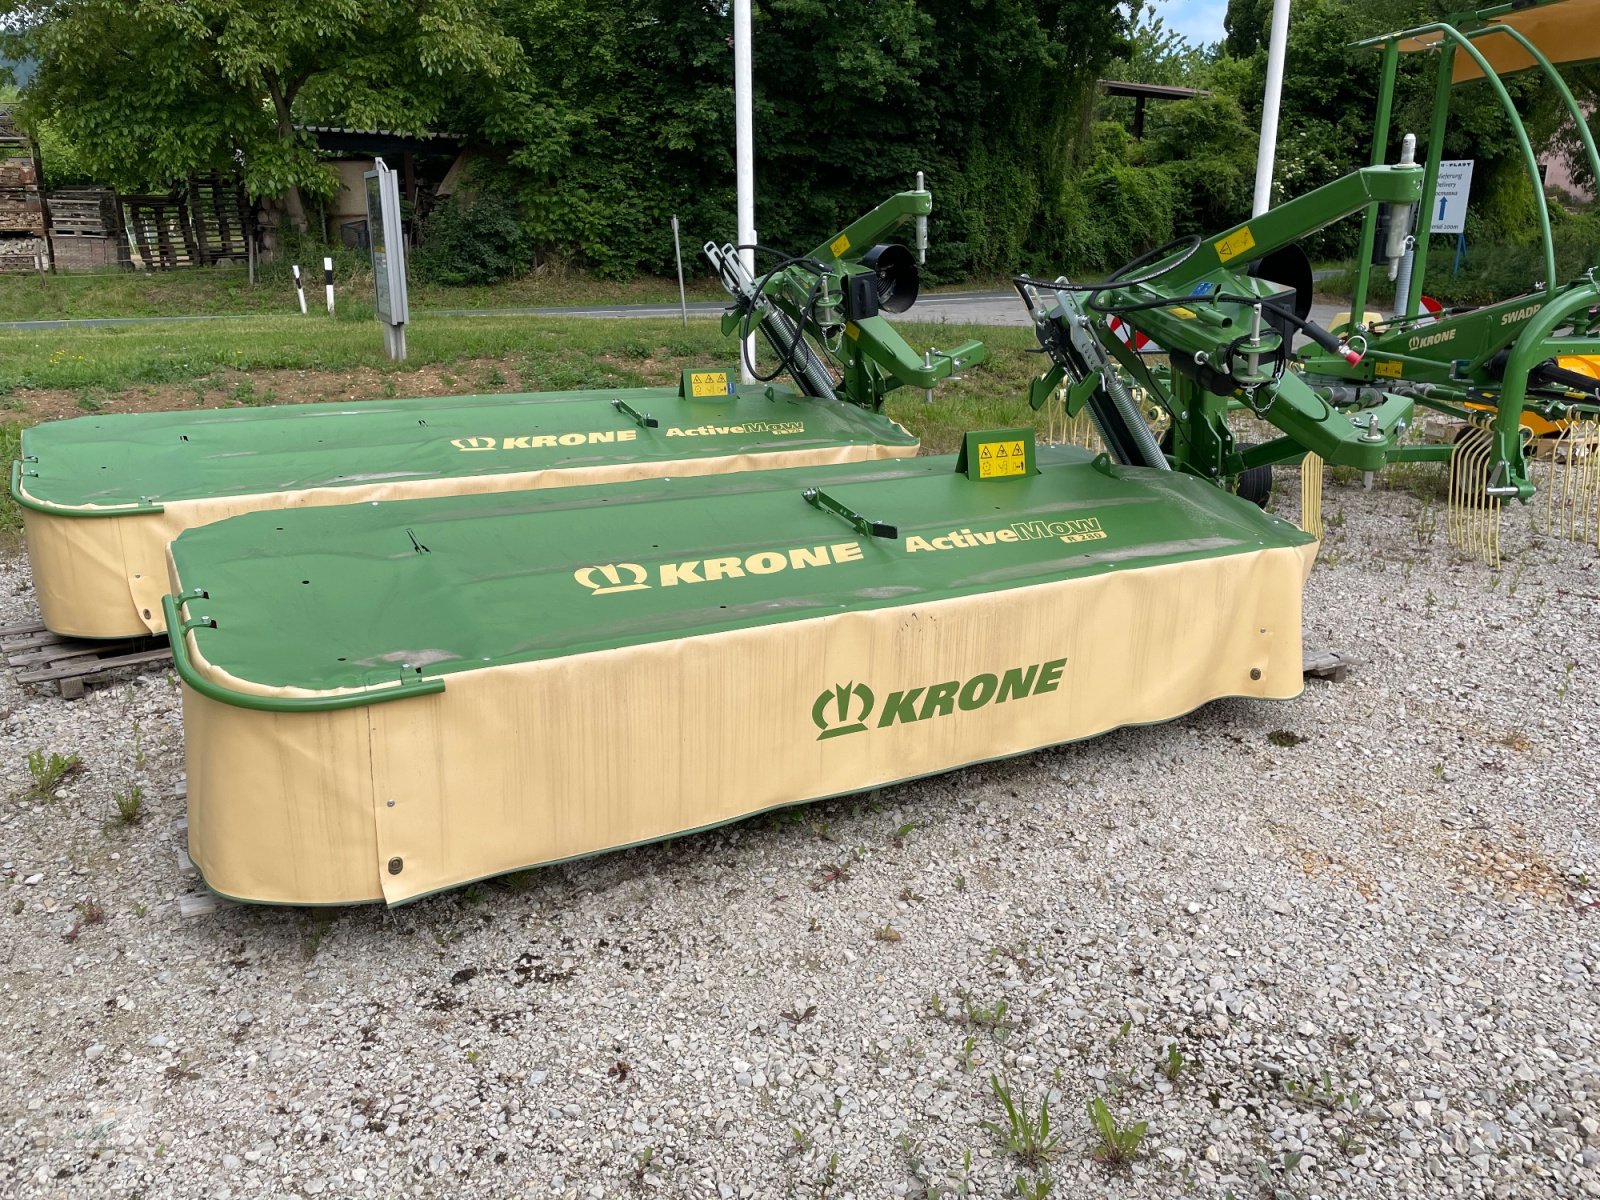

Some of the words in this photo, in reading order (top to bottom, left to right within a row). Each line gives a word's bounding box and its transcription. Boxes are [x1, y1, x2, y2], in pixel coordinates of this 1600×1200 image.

[1438, 172, 1462, 180] lieferung
[1419, 328, 1456, 348] KRONE
[502, 429, 637, 450] KRONE
[905, 517, 1102, 553] ActiveMow
[1079, 532, 1103, 541] 280
[659, 541, 865, 587] KRONE
[877, 657, 1068, 729] KRONE
